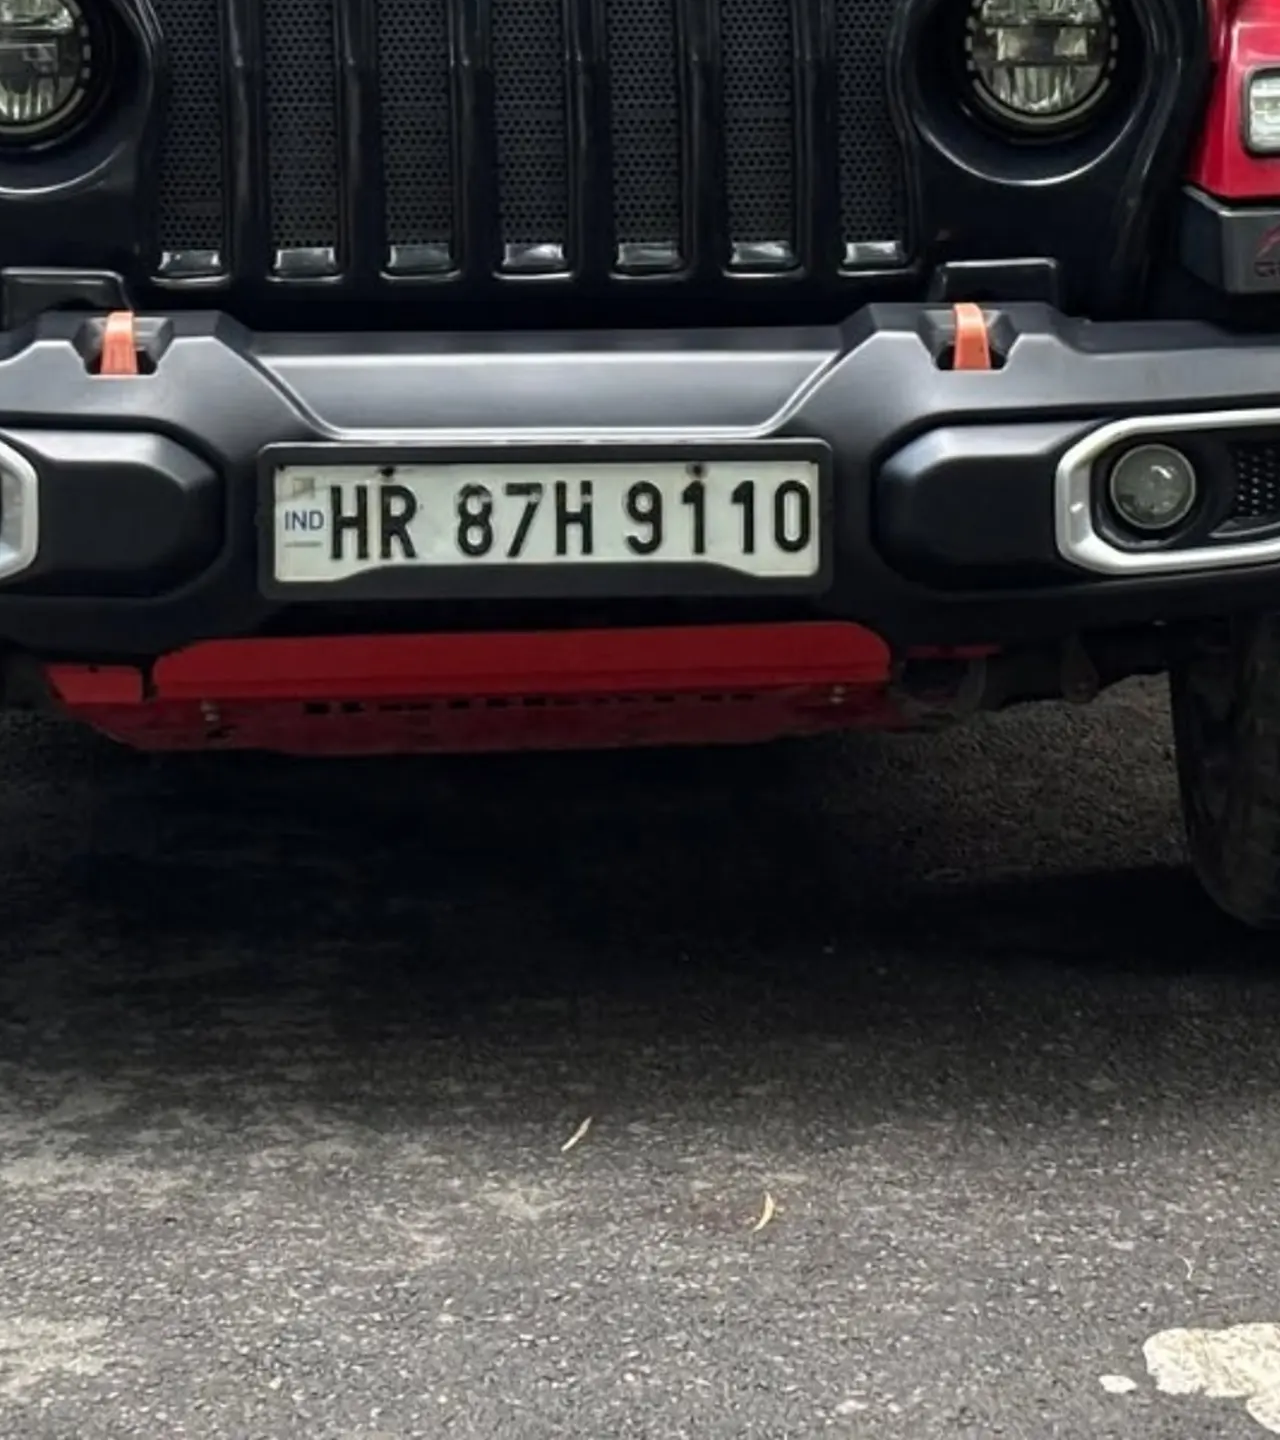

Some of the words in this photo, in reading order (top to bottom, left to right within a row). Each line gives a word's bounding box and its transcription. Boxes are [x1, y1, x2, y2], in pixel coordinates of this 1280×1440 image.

[284, 509, 325, 531] IND
[329, 482, 418, 560] HR
[456, 481, 594, 558] 87H
[623, 479, 812, 556] 9110
